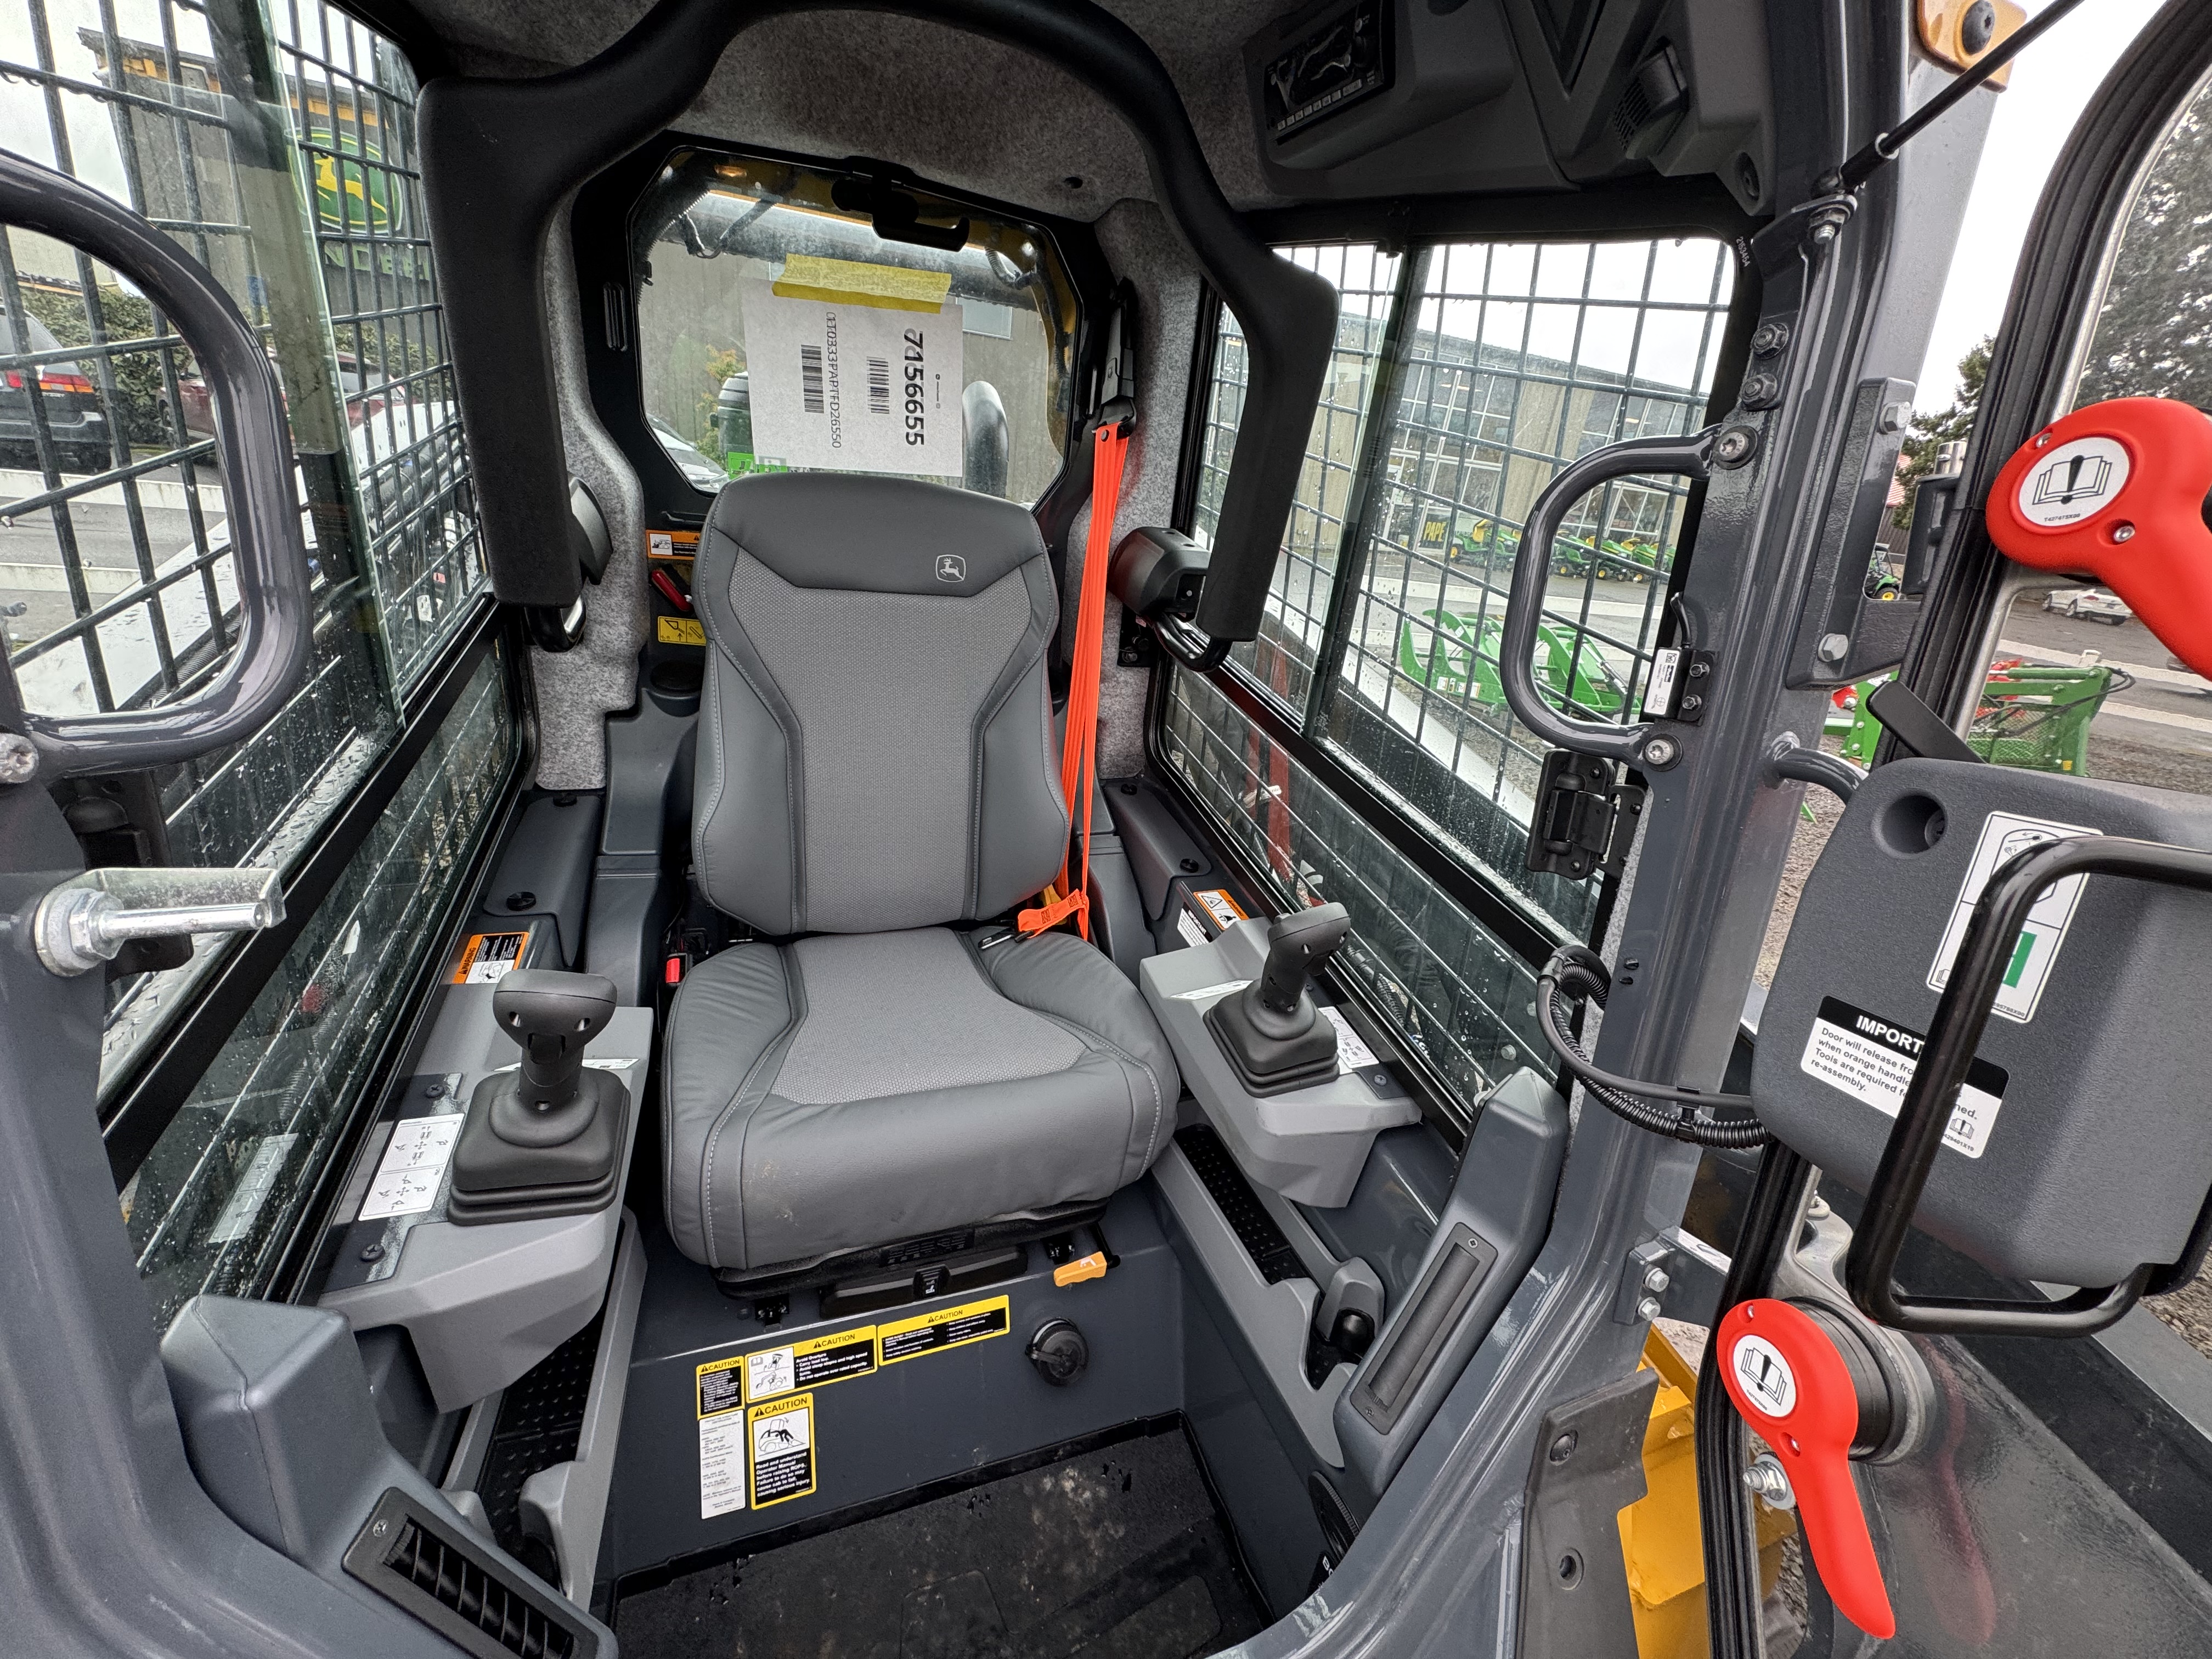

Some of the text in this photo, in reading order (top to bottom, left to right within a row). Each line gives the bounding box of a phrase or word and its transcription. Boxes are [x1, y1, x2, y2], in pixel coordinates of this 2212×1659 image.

[904, 331, 924, 446] 7156655
[1856, 1014, 1925, 1055] IMPORT
[1818, 1039, 1842, 1054] when
[1843, 1049, 1875, 1071] orange
[1821, 1027, 1844, 1043] Door
[1845, 1037, 1861, 1052] will
[1862, 1045, 1898, 1068] release
[1811, 1060, 1866, 1092] re-assembly.
[1815, 1048, 1838, 1064] Tools
[1840, 1061, 1855, 1073] are
[1857, 1068, 1893, 1093] required
[935, 1310, 963, 1321] CAUTION
[822, 1334, 855, 1346] CAUTION
[709, 1359, 740, 1370] CAUTION
[764, 1397, 808, 1415] CAUTION
[780, 1452, 807, 1463] understand
[756, 1466, 778, 1475] Operator
[757, 1478, 774, 1486] Failure
[757, 1488, 776, 1497] causing
